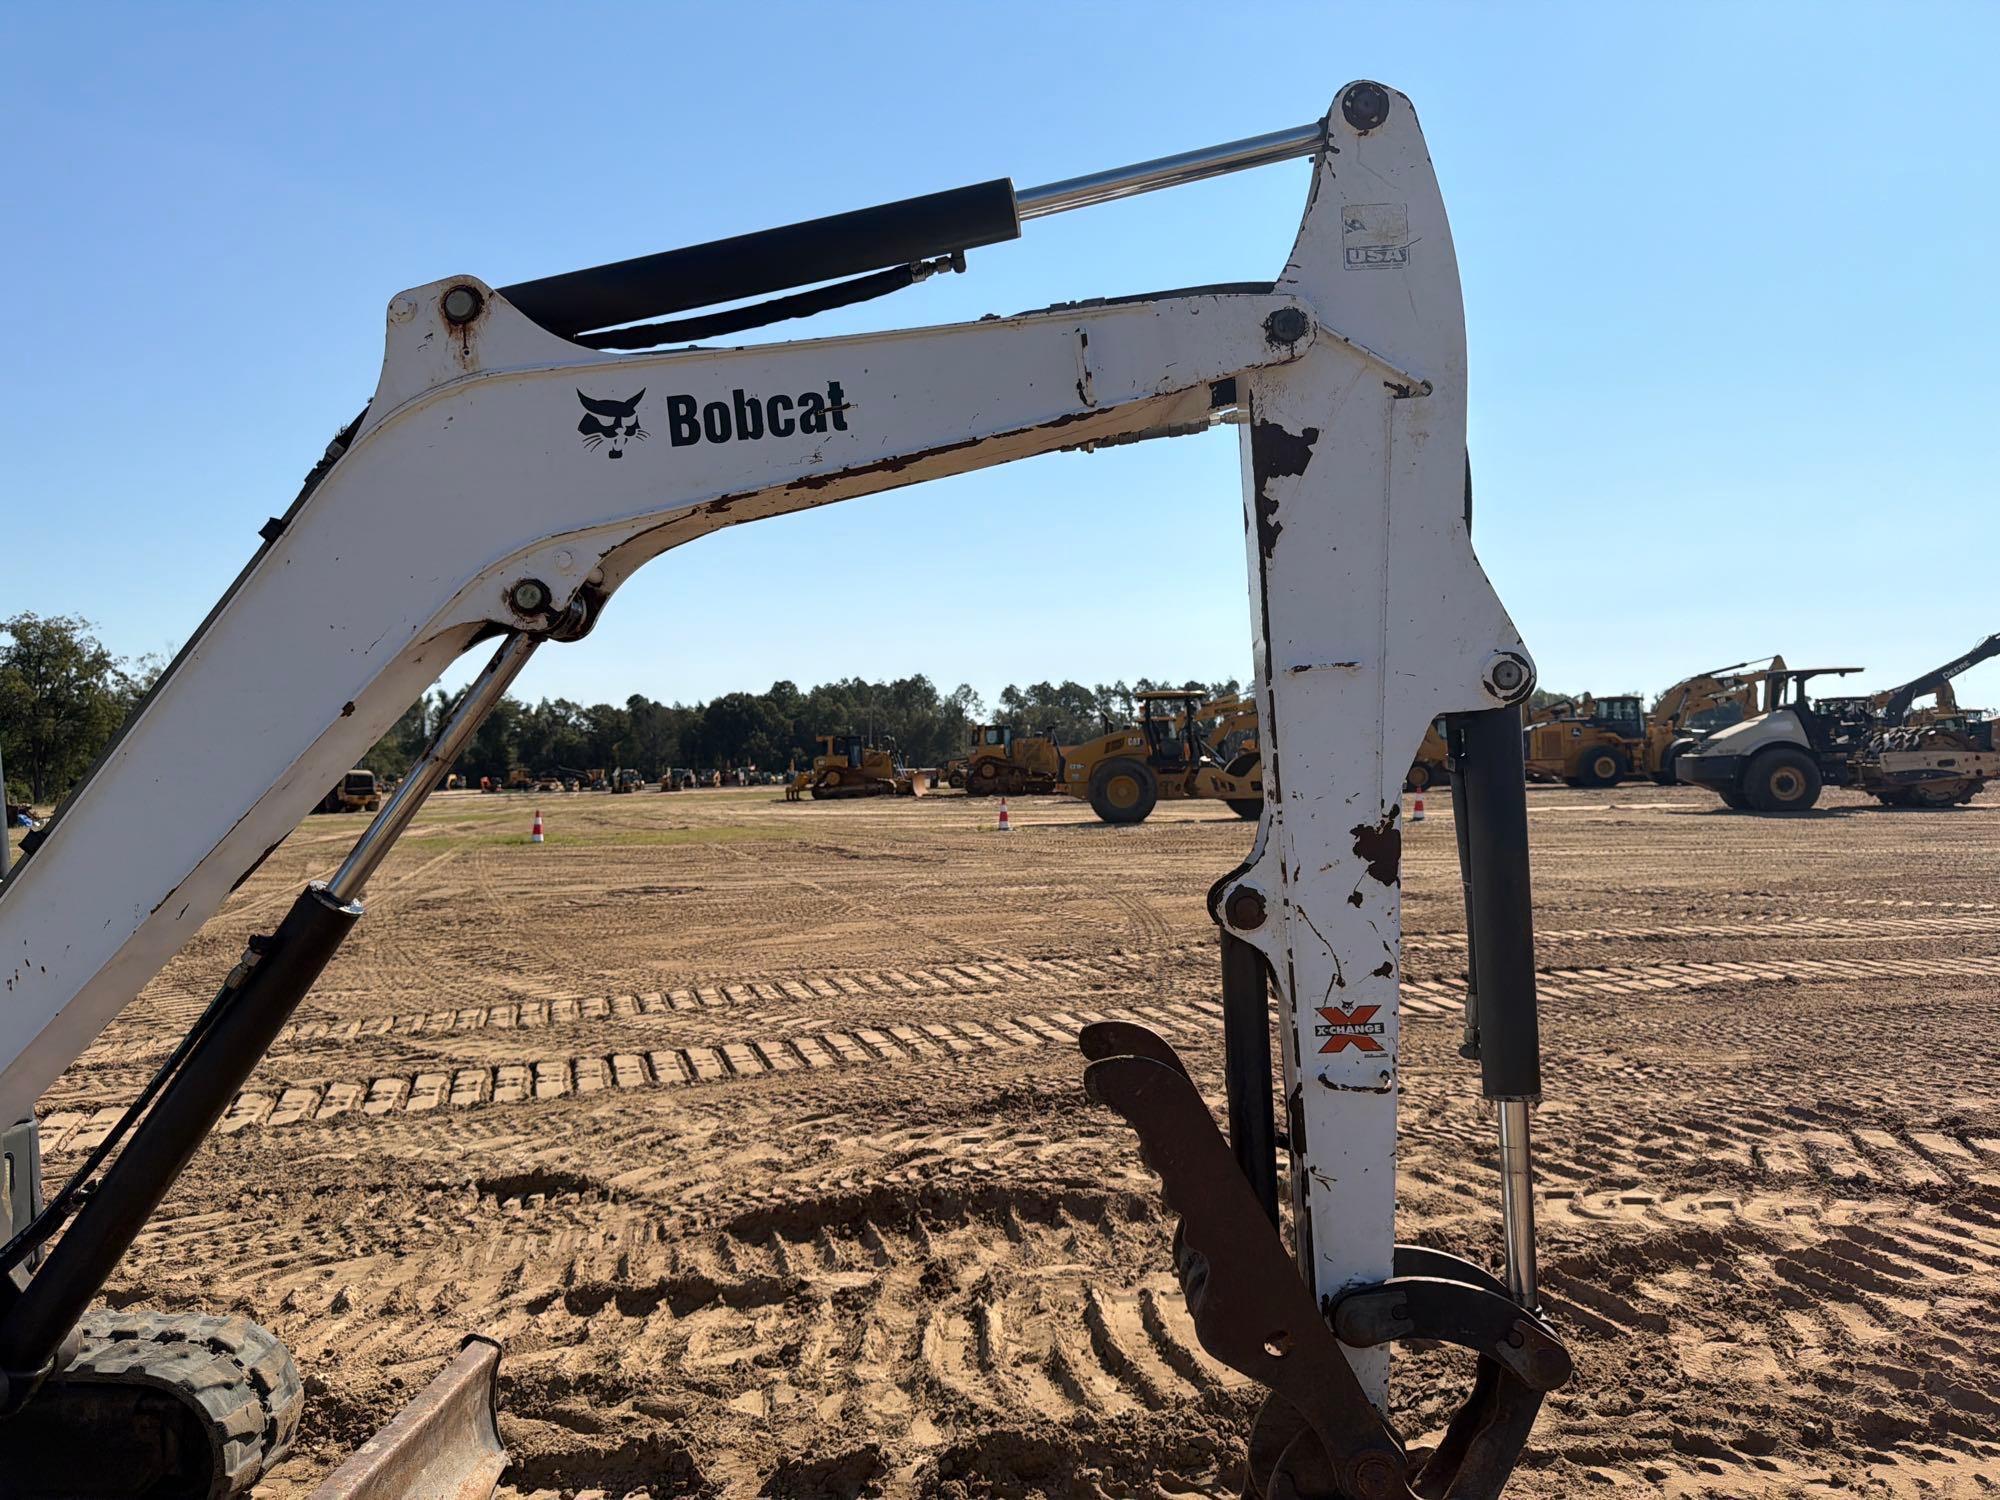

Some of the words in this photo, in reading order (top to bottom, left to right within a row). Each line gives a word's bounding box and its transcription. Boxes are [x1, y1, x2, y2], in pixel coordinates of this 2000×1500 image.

[1346, 248, 1406, 263] USA
[666, 381, 849, 447] Bobcat
[1942, 660, 1970, 680] DEERE
[1127, 737, 1141, 746] CAT
[1316, 1023, 1382, 1036] X-CHANGE
